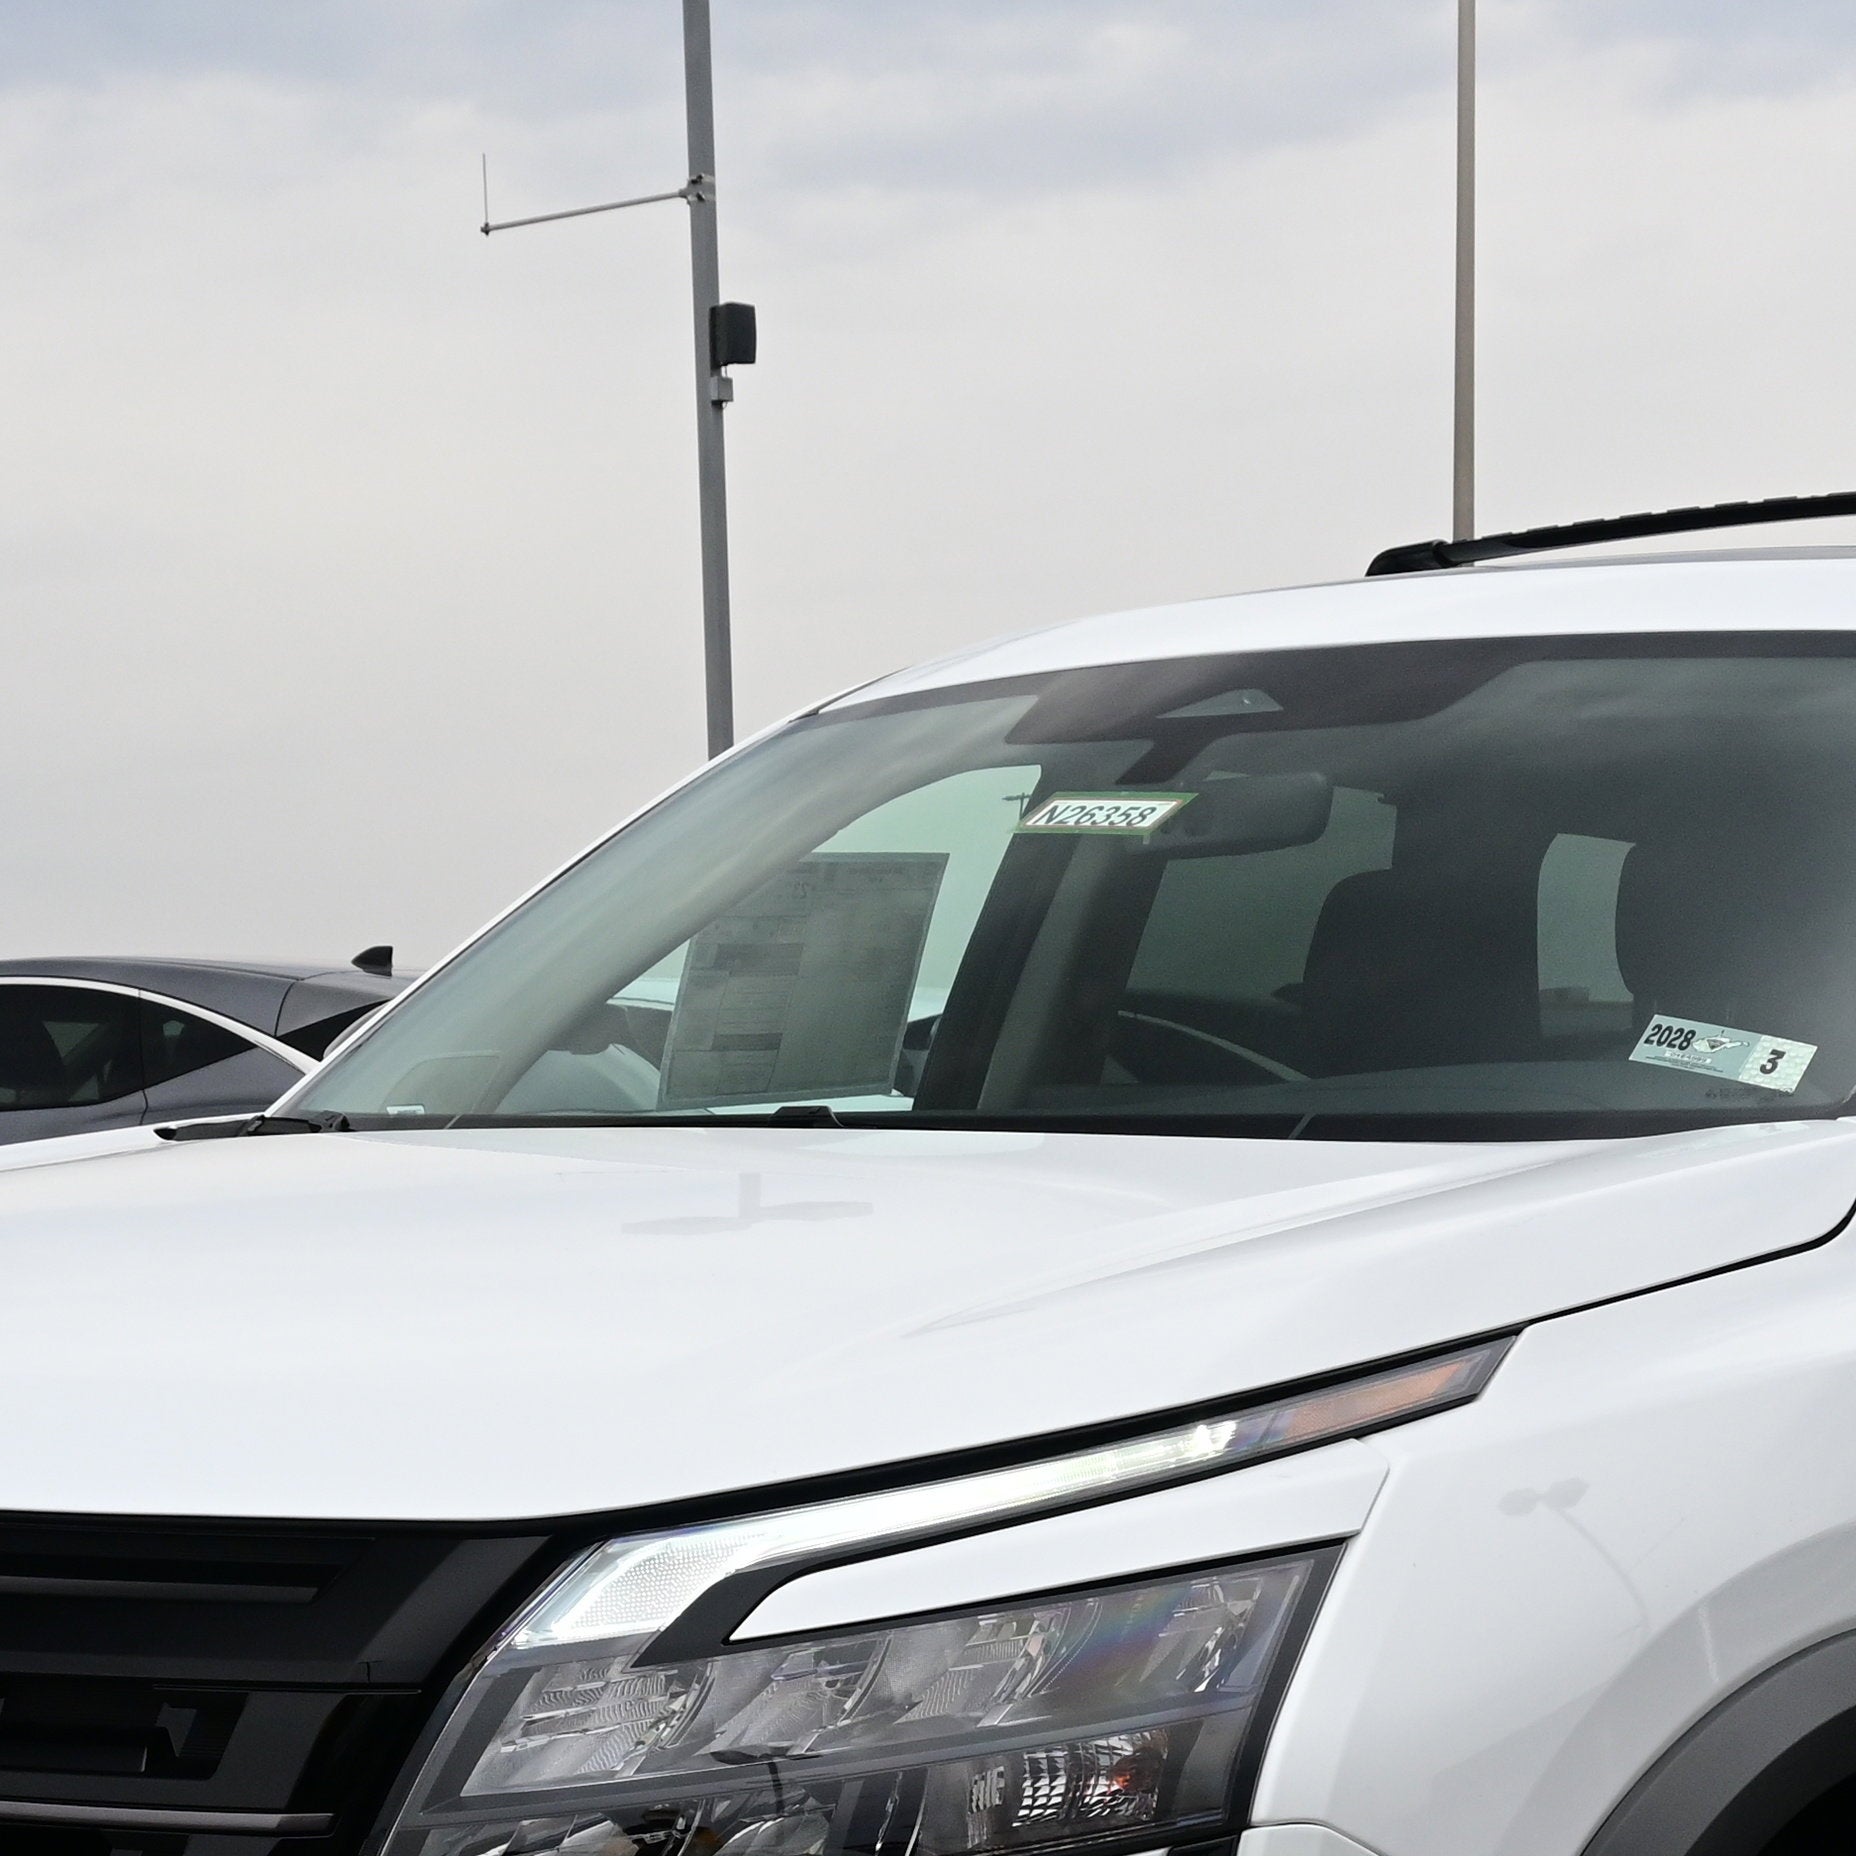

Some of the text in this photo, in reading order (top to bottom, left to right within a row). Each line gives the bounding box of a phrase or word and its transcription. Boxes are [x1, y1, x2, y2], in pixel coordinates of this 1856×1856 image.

[1032, 804, 1158, 827] N26358
[1643, 1023, 1697, 1051] 2028
[1759, 1048, 1787, 1075] 3
